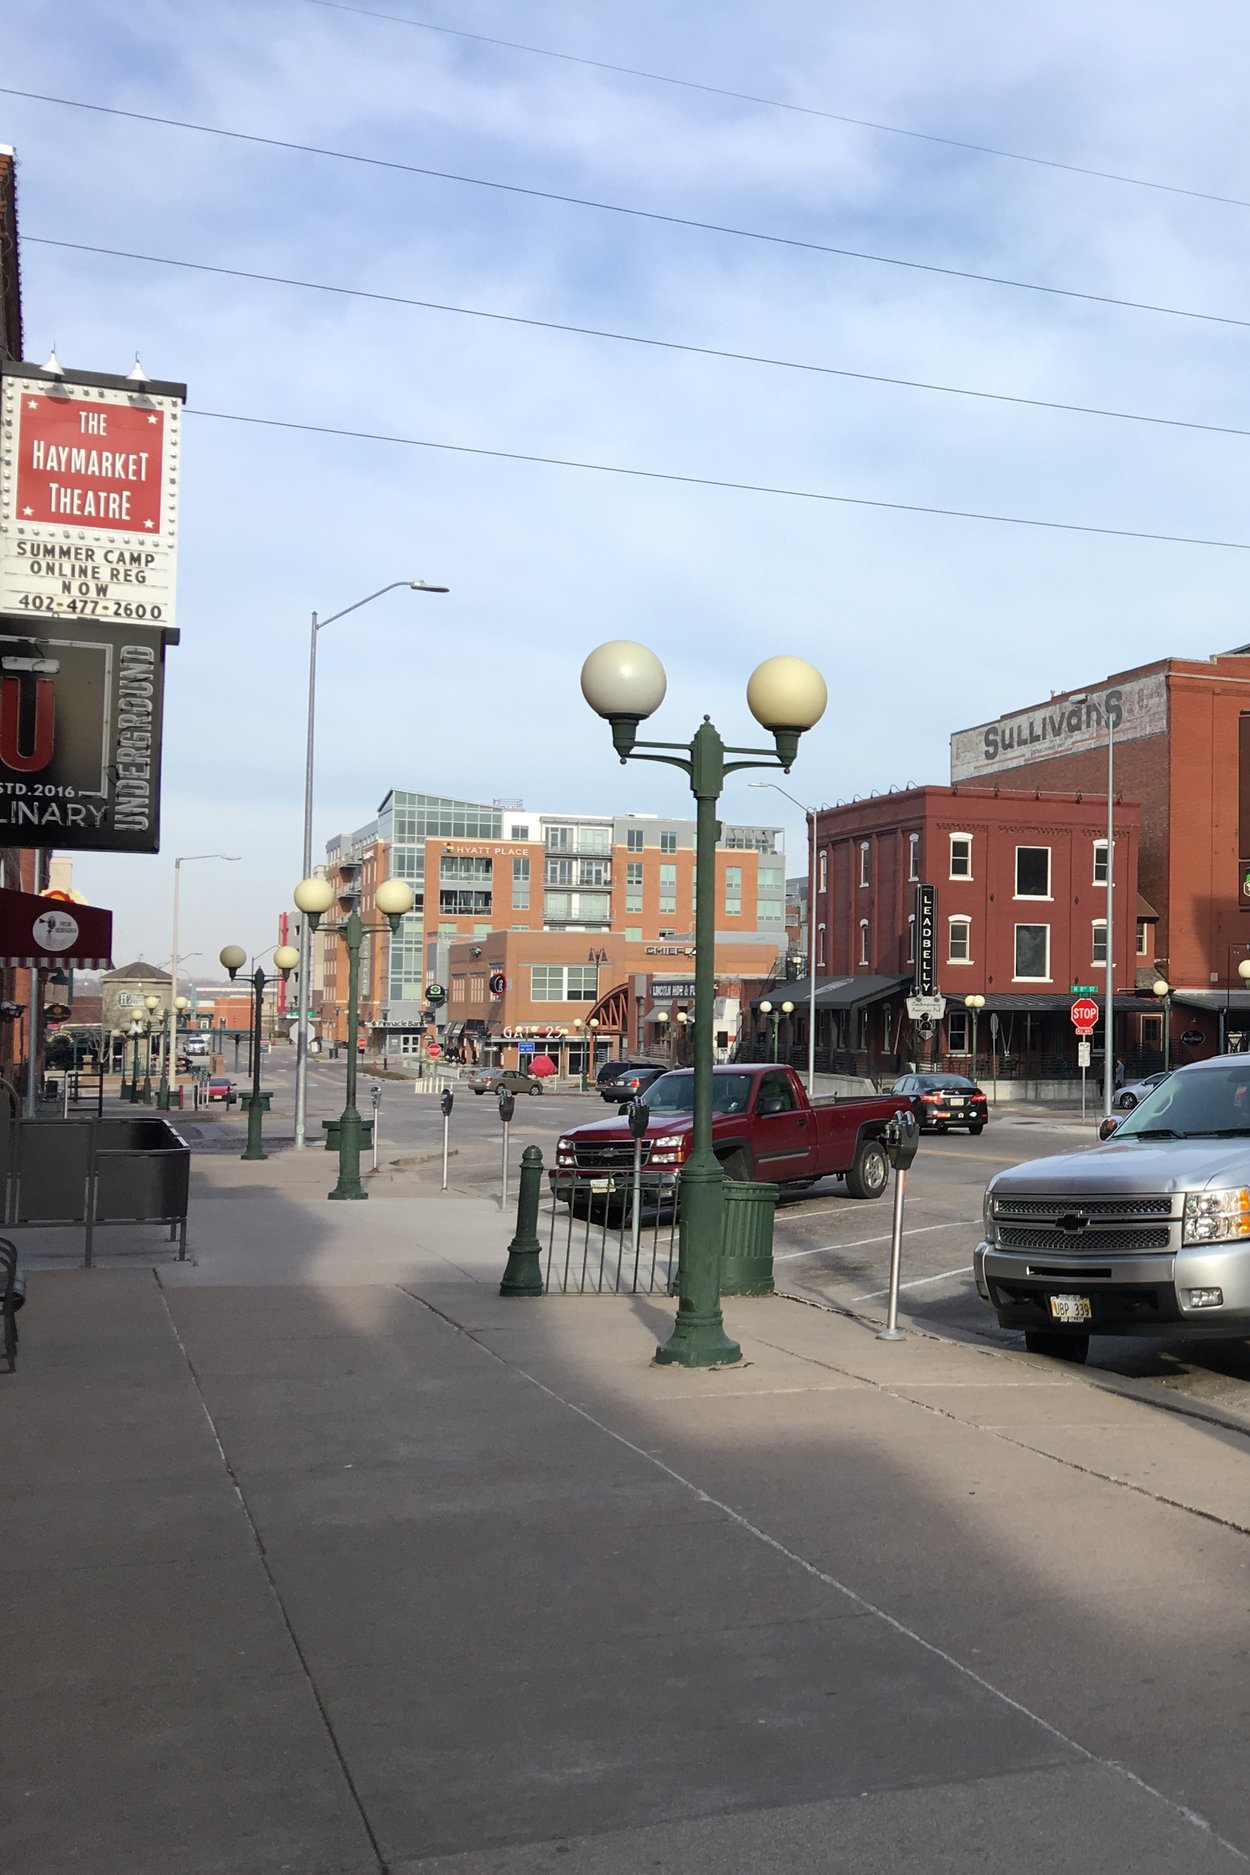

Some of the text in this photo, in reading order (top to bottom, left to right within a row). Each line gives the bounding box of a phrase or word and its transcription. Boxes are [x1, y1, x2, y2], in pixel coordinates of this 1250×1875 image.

[79, 411, 107, 436] THE
[32, 439, 149, 482] HAYMARKET
[49, 482, 131, 521] THEATRE
[17, 541, 156, 568] SUMMER CAMP
[29, 560, 147, 584] ONLINE REG
[61, 580, 109, 598] NOW
[18, 595, 162, 619] 402-477-2600
[115, 645, 154, 831] UNDERGROUND
[923, 895, 932, 992] LEADBELLY
[1074, 1008, 1096, 1019] STOP
[546, 1026, 562, 1038] 25
